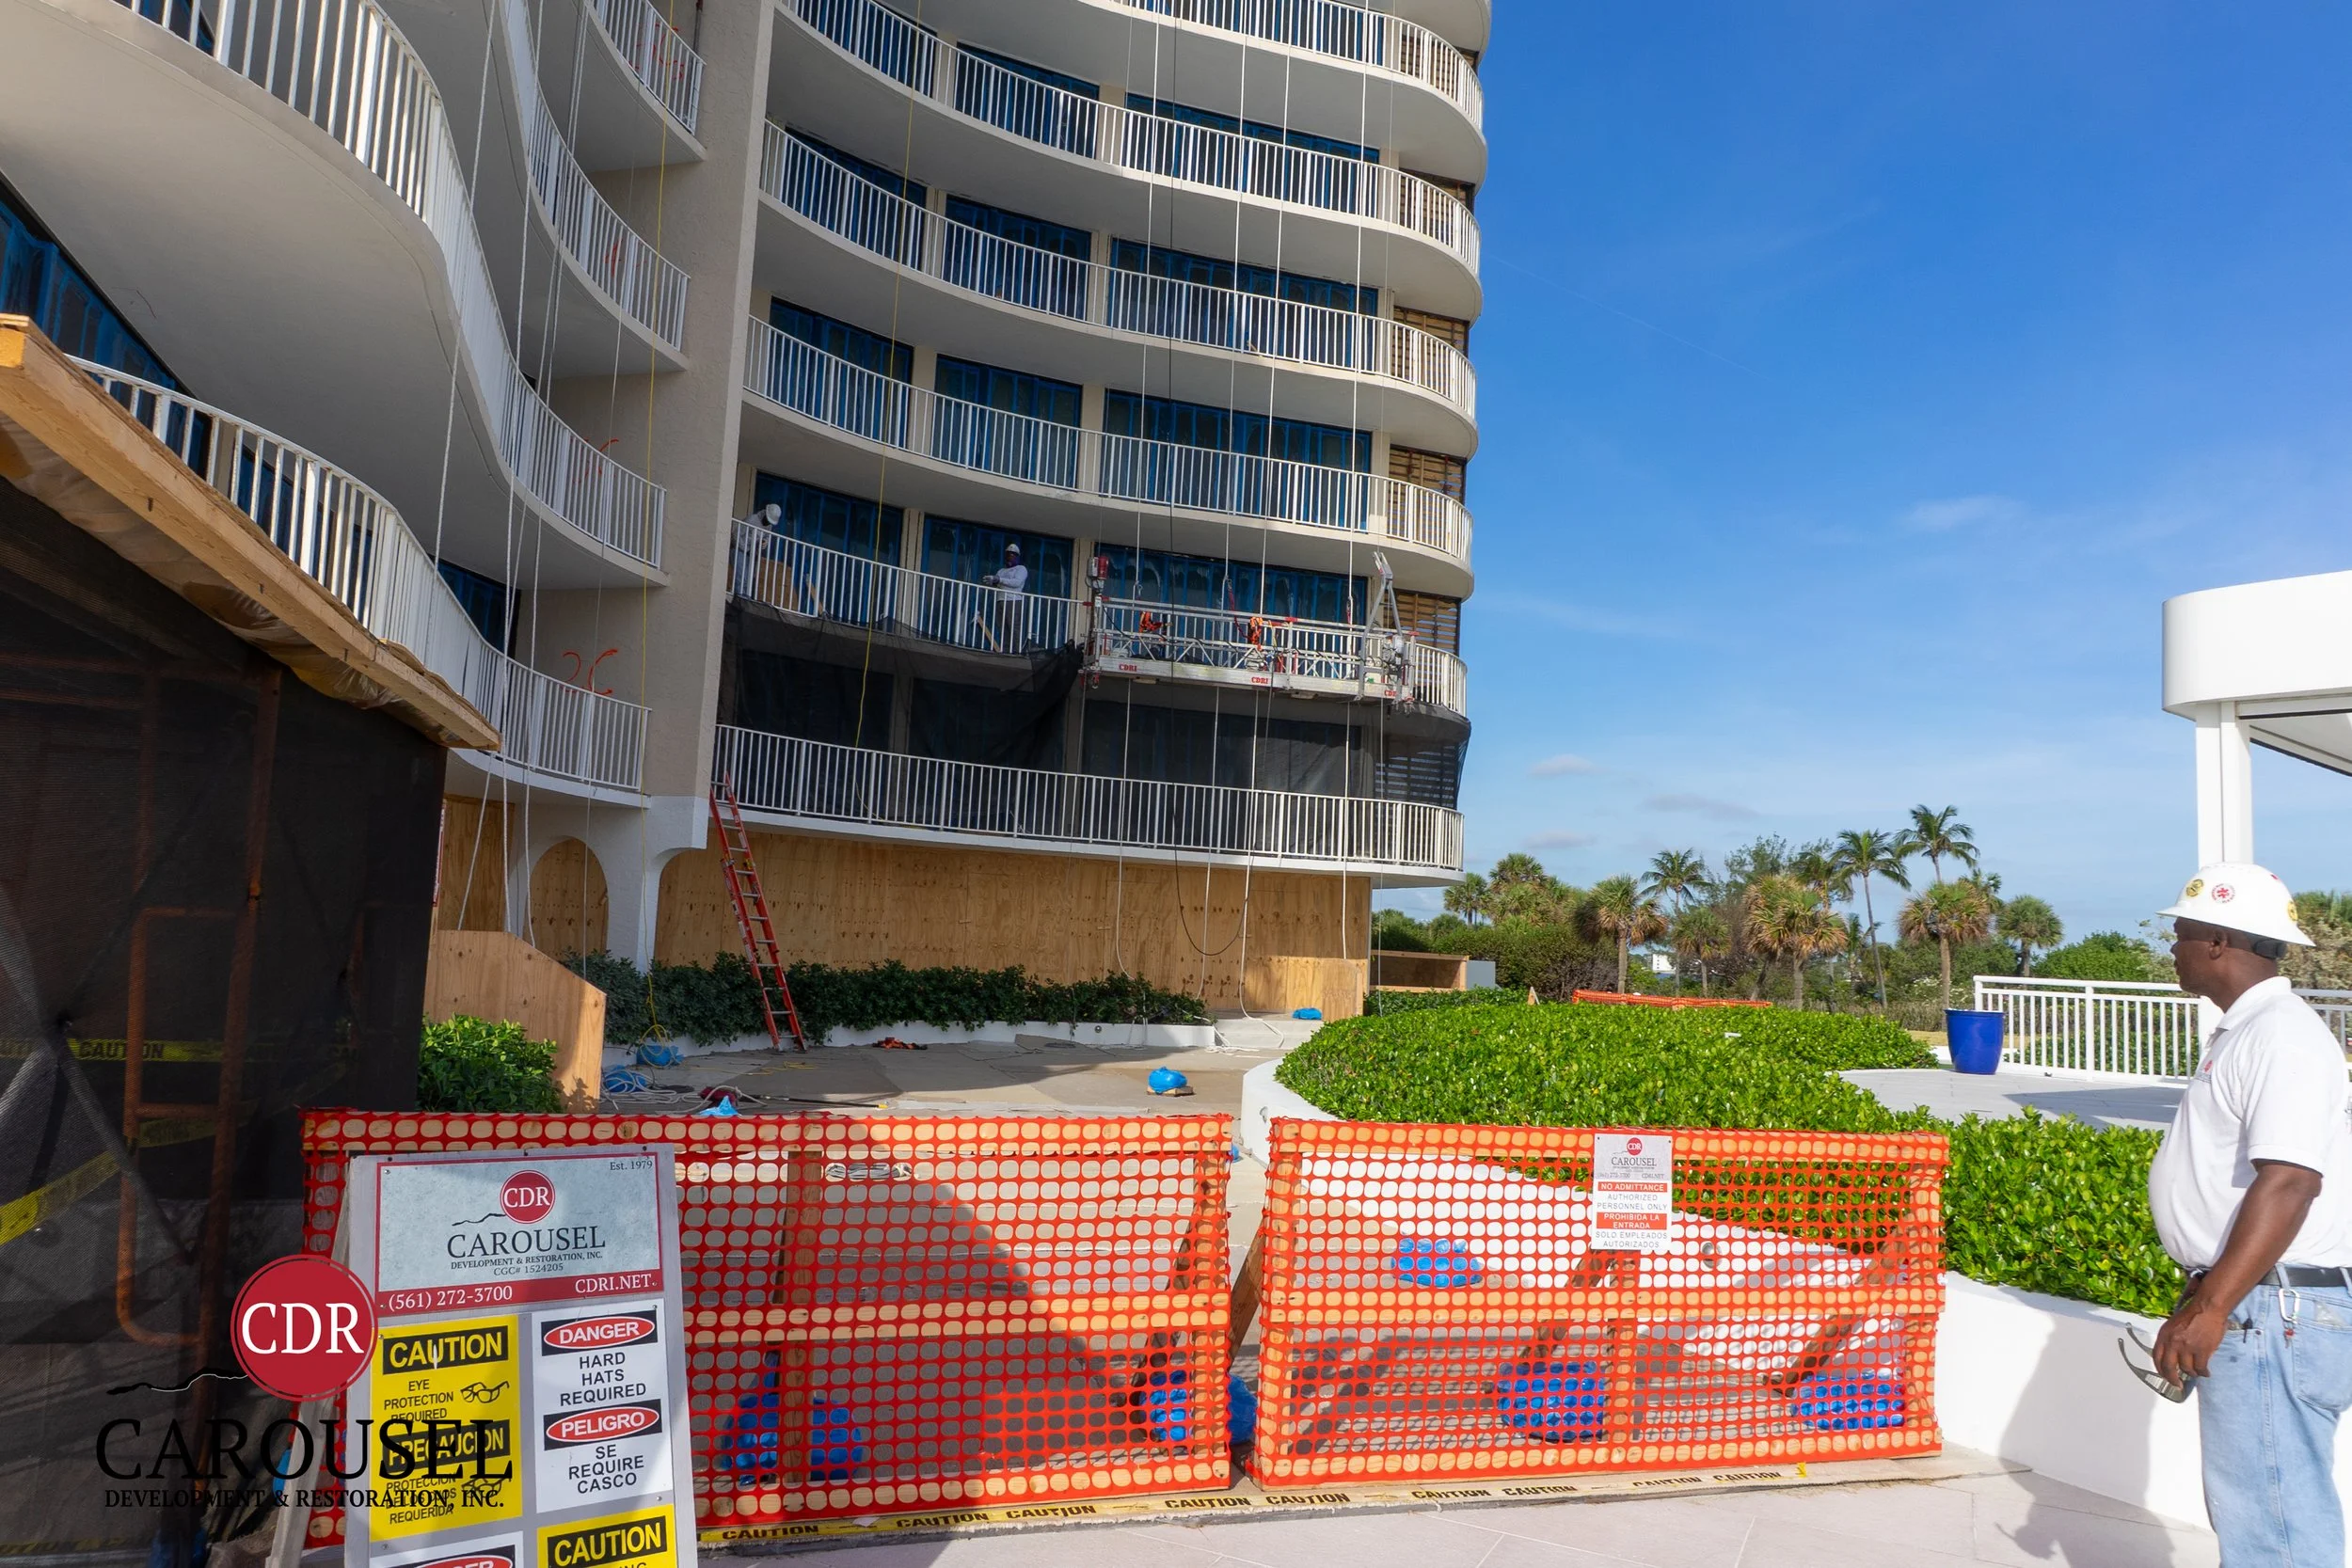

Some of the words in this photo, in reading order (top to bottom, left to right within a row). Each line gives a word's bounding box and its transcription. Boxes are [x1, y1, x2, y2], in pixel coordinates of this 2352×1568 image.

[1119, 663, 1137, 672] CDRI
[1251, 676, 1269, 685] CDRI
[79, 1039, 164, 1059] CAUTON
[1627, 1142, 1642, 1150] CDR
[610, 1161, 628, 1171] Est.
[630, 1159, 653, 1170] 1979
[1611, 1157, 1657, 1166] CAROUSEL
[502, 1186, 550, 1208] CDR
[447, 1226, 606, 1259] CAROUSEL
[451, 1258, 514, 1270] DEVELOPMENT
[516, 1256, 523, 1265] &
[525, 1251, 585, 1264] RESTORATION,
[586, 1250, 603, 1259] INC.
[493, 1265, 520, 1276] CGC#
[524, 1262, 564, 1274] 1524205
[389, 1290, 432, 1311] (561)
[437, 1285, 513, 1307] 272-3700
[575, 1273, 652, 1293] CDRI.NET
[559, 1322, 640, 1344] DANGER
[389, 1332, 501, 1368] CAUTION
[580, 1352, 626, 1370] HARD
[408, 1379, 430, 1392] EYE
[581, 1369, 625, 1386] HATS
[384, 1391, 453, 1410] PROTECTION
[560, 1383, 646, 1407] REQUIRED
[391, 1407, 447, 1424] REQUIRED
[561, 1414, 645, 1438] PELIGRO
[389, 1427, 503, 1466] PREAUCION
[596, 1444, 617, 1460] SE
[568, 1455, 644, 1480] REQUIRE
[577, 1472, 637, 1494] CASCO
[1166, 1497, 1252, 1509] CAUTION
[1265, 1493, 1351, 1505] CAUTION
[389, 1505, 453, 1525] REQUERIDA
[896, 1513, 989, 1528] CAUTION
[1006, 1505, 1096, 1519] CAUTION
[723, 1525, 818, 1541] CAUTION
[554, 1522, 661, 1567] CAUTION
